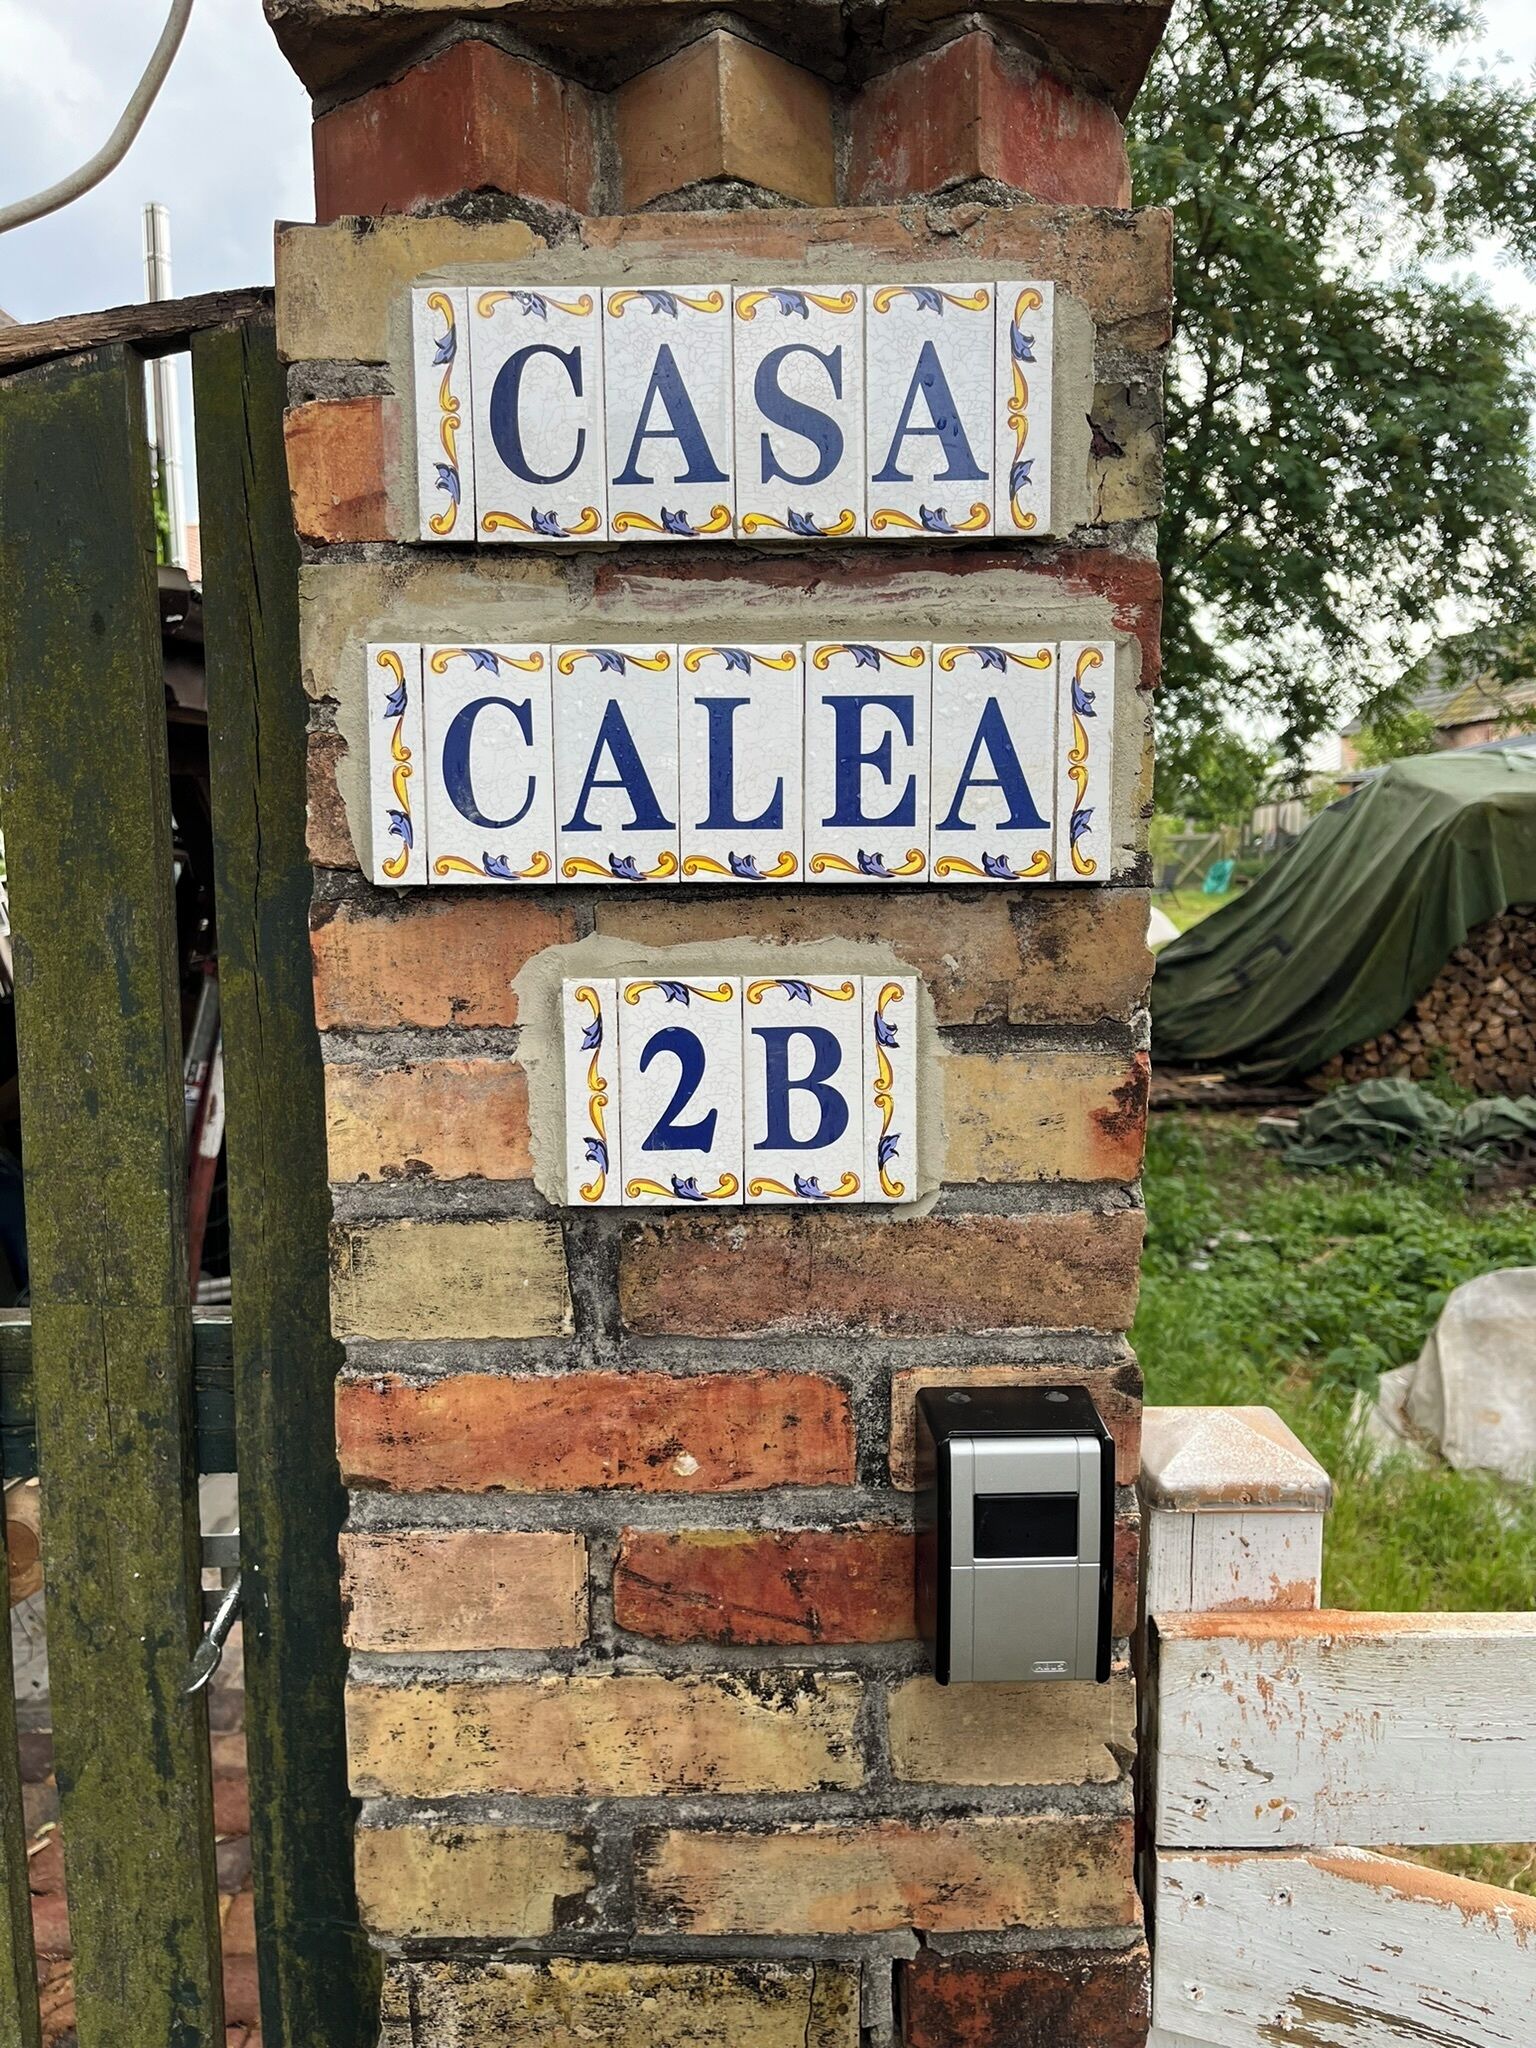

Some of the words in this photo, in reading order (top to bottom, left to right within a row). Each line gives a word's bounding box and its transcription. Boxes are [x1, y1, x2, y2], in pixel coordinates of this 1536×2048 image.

[490, 341, 988, 486] CASA
[441, 695, 1050, 832] CALEA
[639, 1026, 849, 1153] 2B
